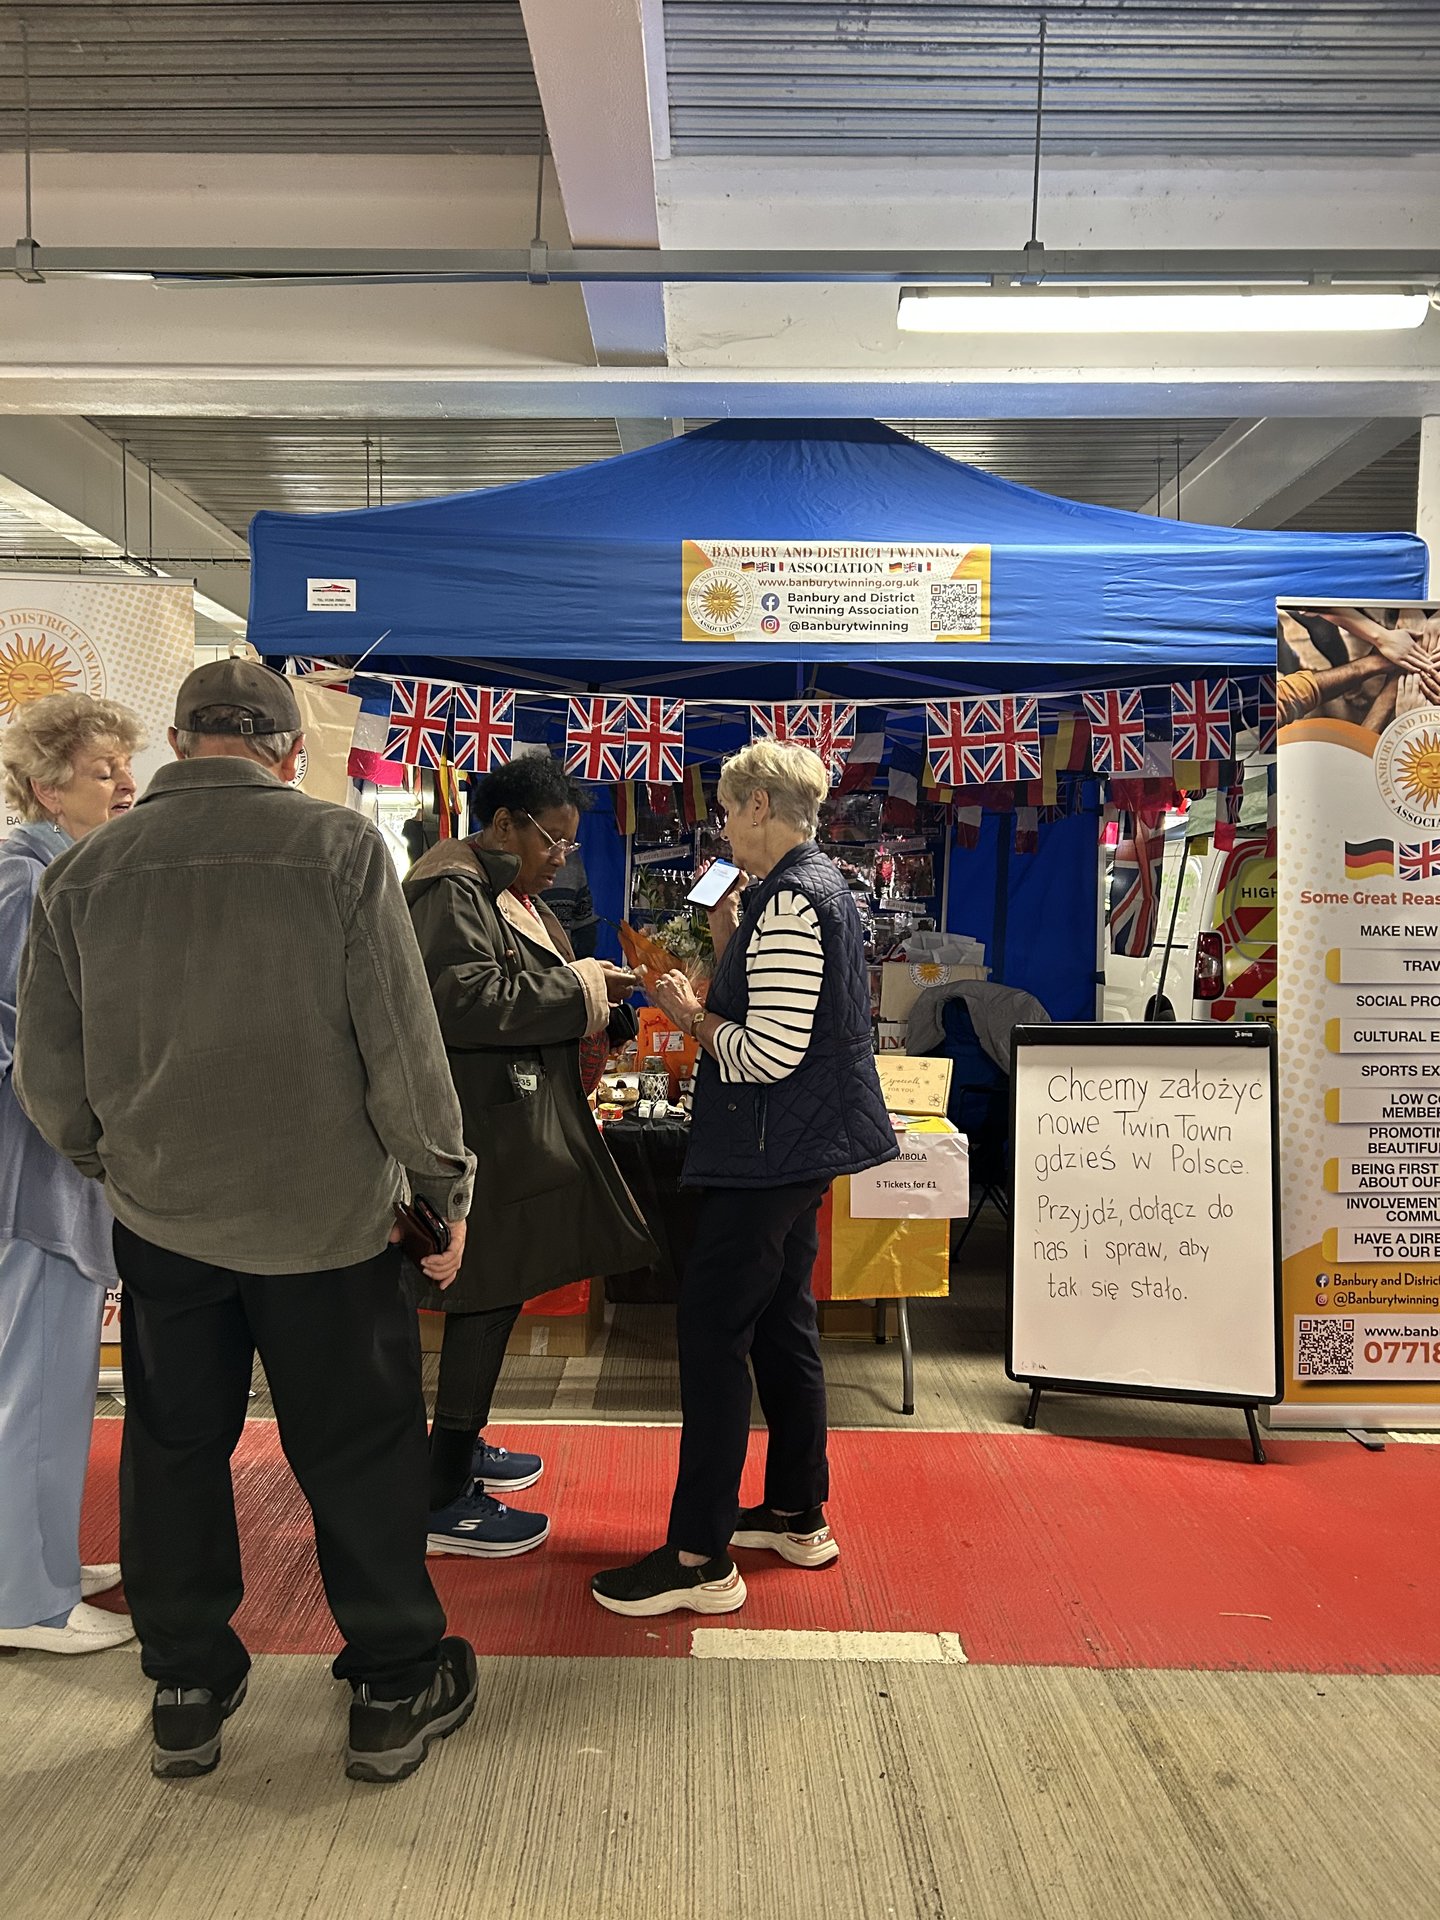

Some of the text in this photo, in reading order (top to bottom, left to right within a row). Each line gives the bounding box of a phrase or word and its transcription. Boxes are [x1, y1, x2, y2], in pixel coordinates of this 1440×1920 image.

[712, 546, 960, 559] BANBURY AND DISTRICT TWINNING
[787, 562, 883, 574] ASSOCIATION
[757, 578, 919, 589] www.banburytwinning.org.uk
[788, 593, 915, 605] Banbury and District
[788, 605, 919, 617] Twinning Association
[788, 621, 909, 633] @Banburytwinning
[10, 612, 102, 697] DISTRICT TWINNI
[1378, 738, 1394, 796] BANBURY
[1394, 717, 1416, 736] AND
[1300, 890, 1349, 905] Some
[1353, 891, 1397, 905] Great
[1360, 926, 1438, 937] MAKE NEW
[1356, 995, 1407, 1007] SOCIAL
[1353, 1031, 1427, 1042] CULTURAL
[1361, 1065, 1418, 1077] SPORTS
[1048, 1066, 1263, 1115] Chcemy założyć
[1391, 1093, 1424, 1105] LOW
[1037, 1110, 1232, 1142] nowe Twin Town
[1368, 1142, 1440, 1154] BEAUTIFU
[1034, 1143, 1249, 1182] gdzieś w Polsce.
[1351, 1163, 1439, 1175] BEING FIRST
[876, 1181, 937, 1189] 5 Tickets for £1
[1358, 1176, 1409, 1188] ABOUT
[1129, 1194, 1197, 1225] dołącz
[1208, 1193, 1234, 1220] do
[1354, 1232, 1392, 1245] HAVE
[1395, 1232, 1407, 1245] A
[1033, 1237, 1210, 1266] nas i spraw, aby
[1373, 1246, 1394, 1258] TO
[1398, 1246, 1430, 1258] OUR
[1047, 1272, 1189, 1301] tak się stało.
[1333, 1273, 1379, 1289] Banbury
[1380, 1273, 1402, 1286] and
[1333, 1290, 1439, 1308] @Banburytwinning
[1364, 1326, 1440, 1337] www.banb
